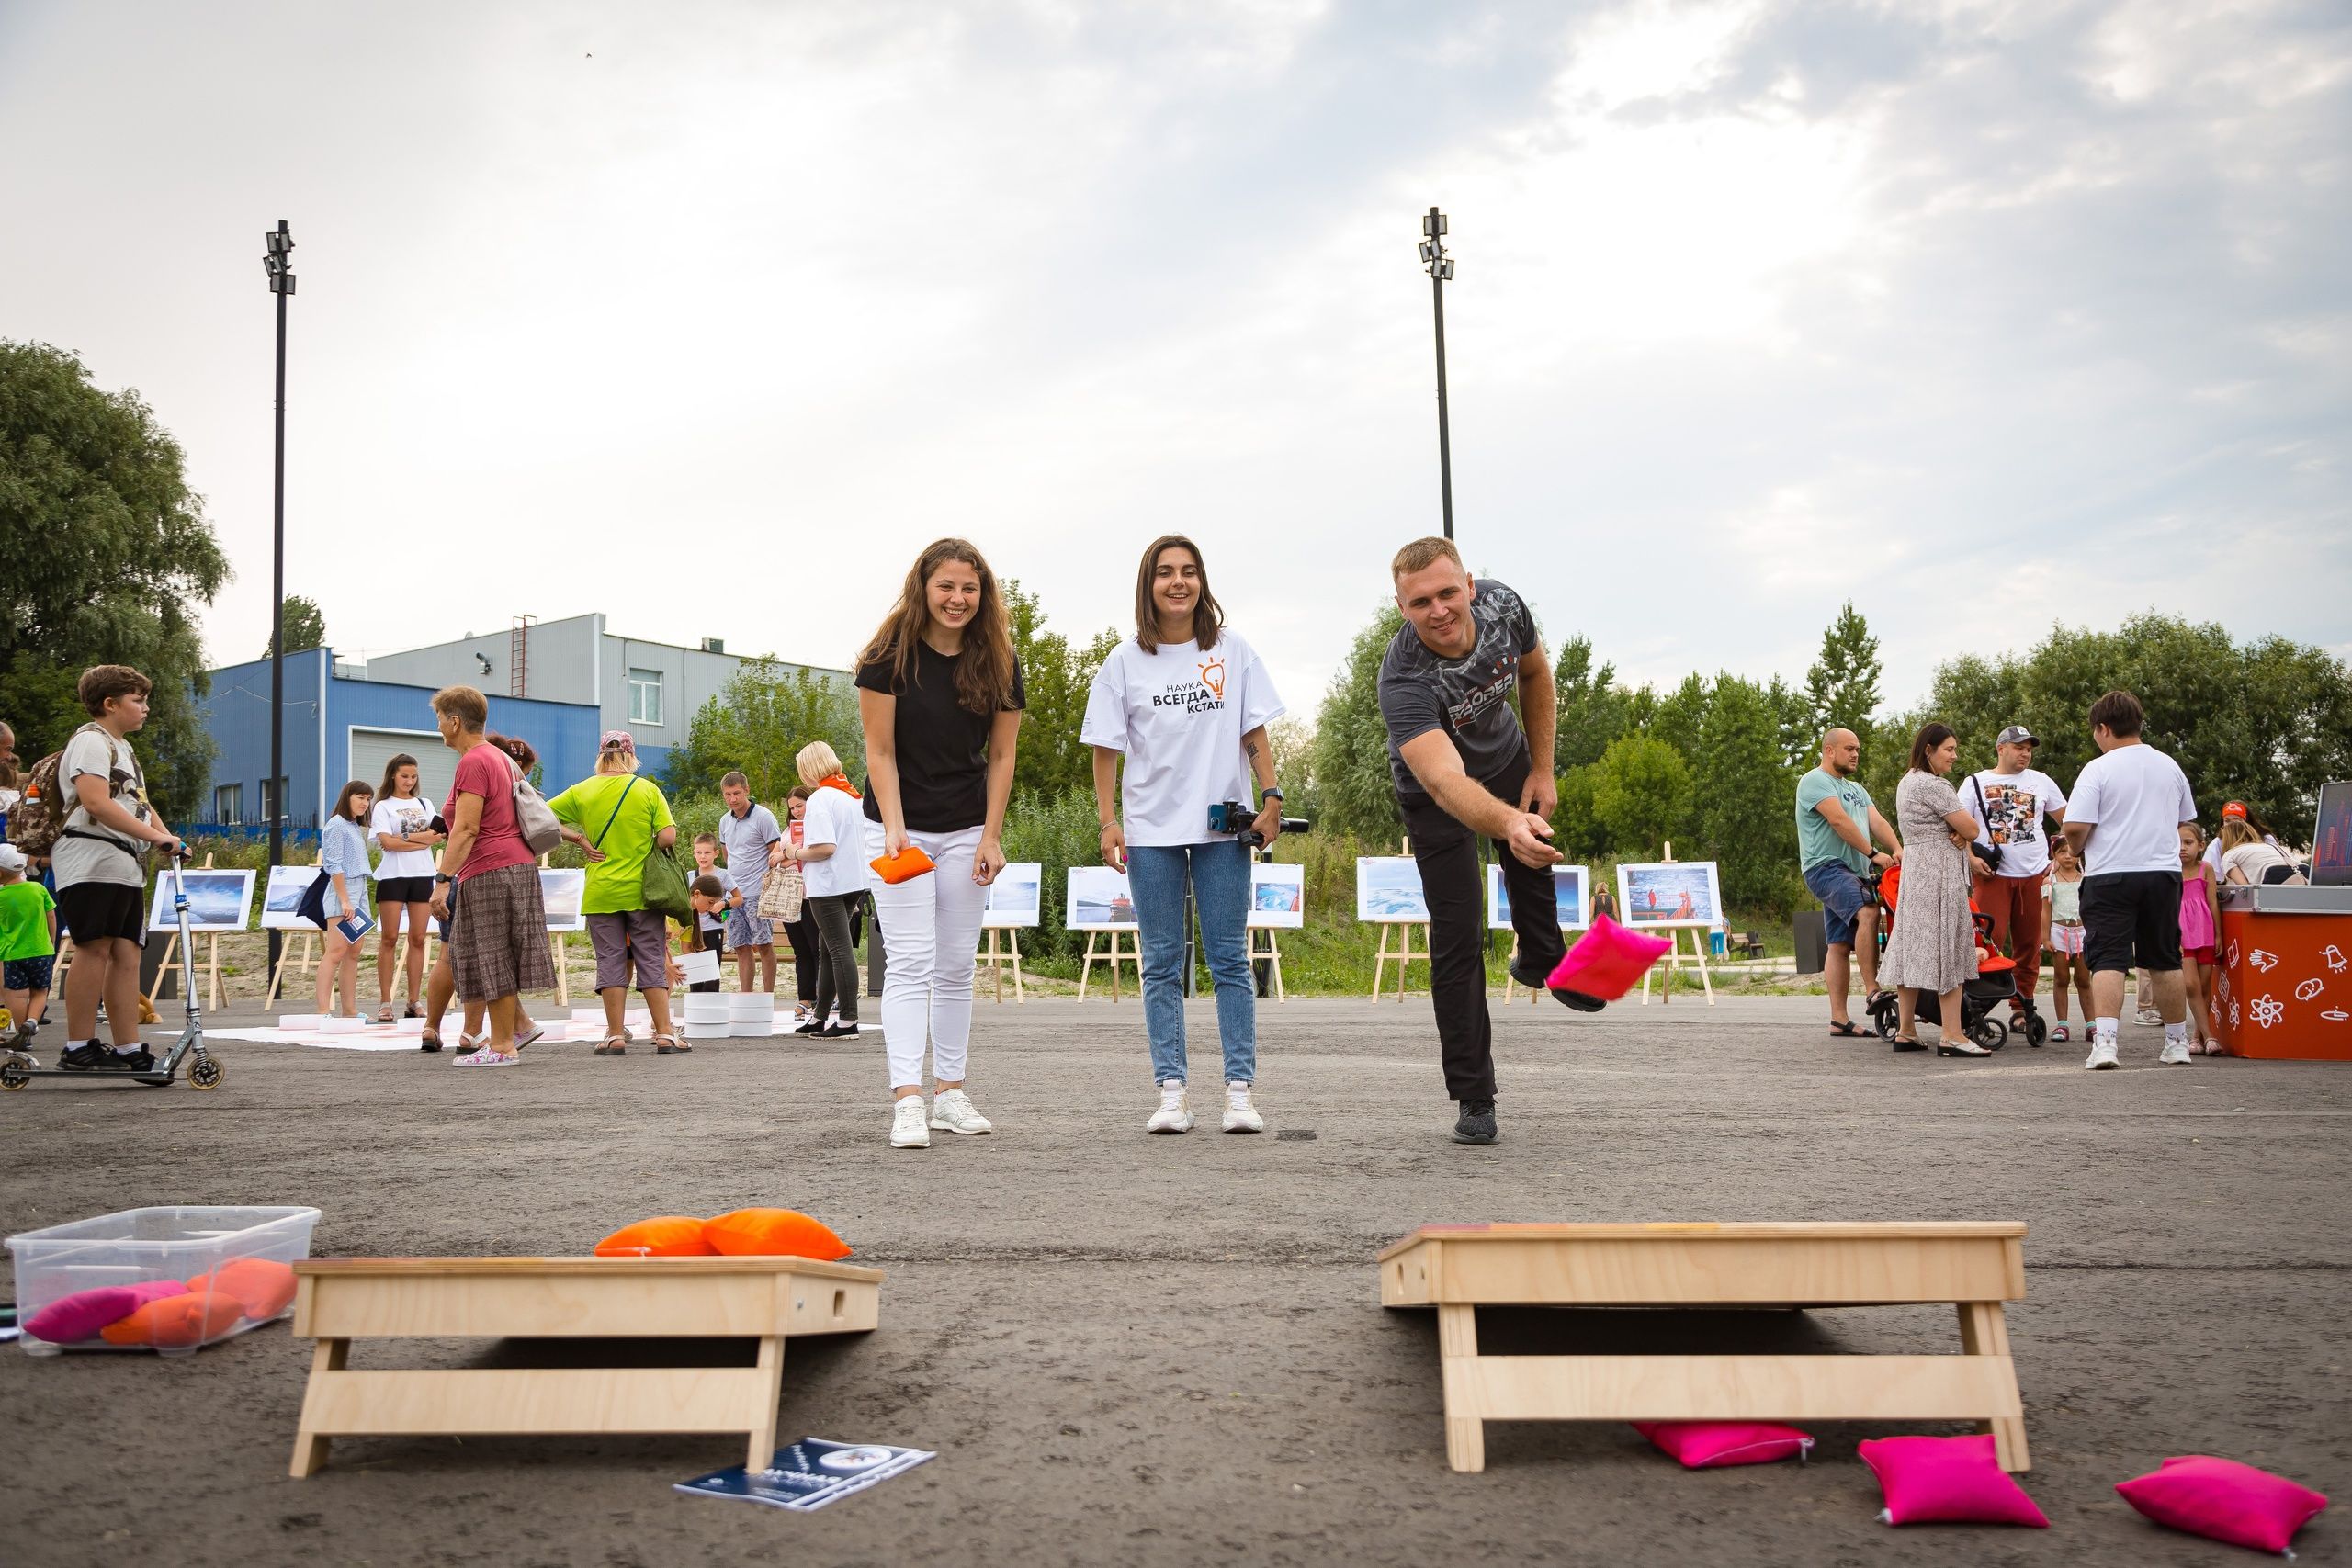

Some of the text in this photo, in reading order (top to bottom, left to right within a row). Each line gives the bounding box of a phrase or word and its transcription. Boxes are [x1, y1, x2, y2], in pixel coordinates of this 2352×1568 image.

[1167, 681, 1204, 693] НАУКА
[1152, 688, 1211, 707] ВСЕГДА
[1187, 700, 1225, 714] КСТАТИ
